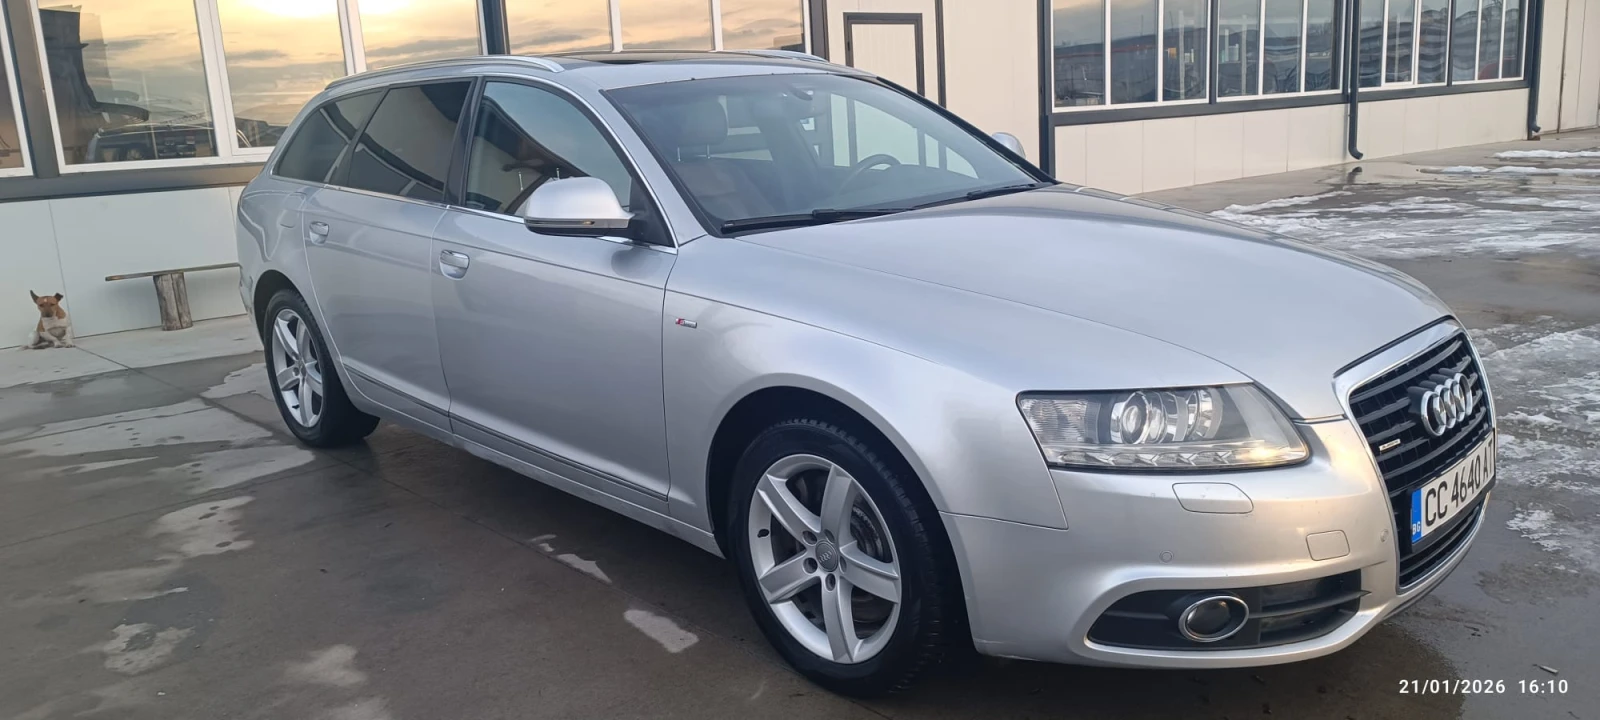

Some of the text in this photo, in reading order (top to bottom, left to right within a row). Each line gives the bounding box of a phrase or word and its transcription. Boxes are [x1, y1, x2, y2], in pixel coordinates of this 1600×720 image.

[1425, 439, 1493, 527] CC 4640 AT
[1412, 521, 1421, 535] BG
